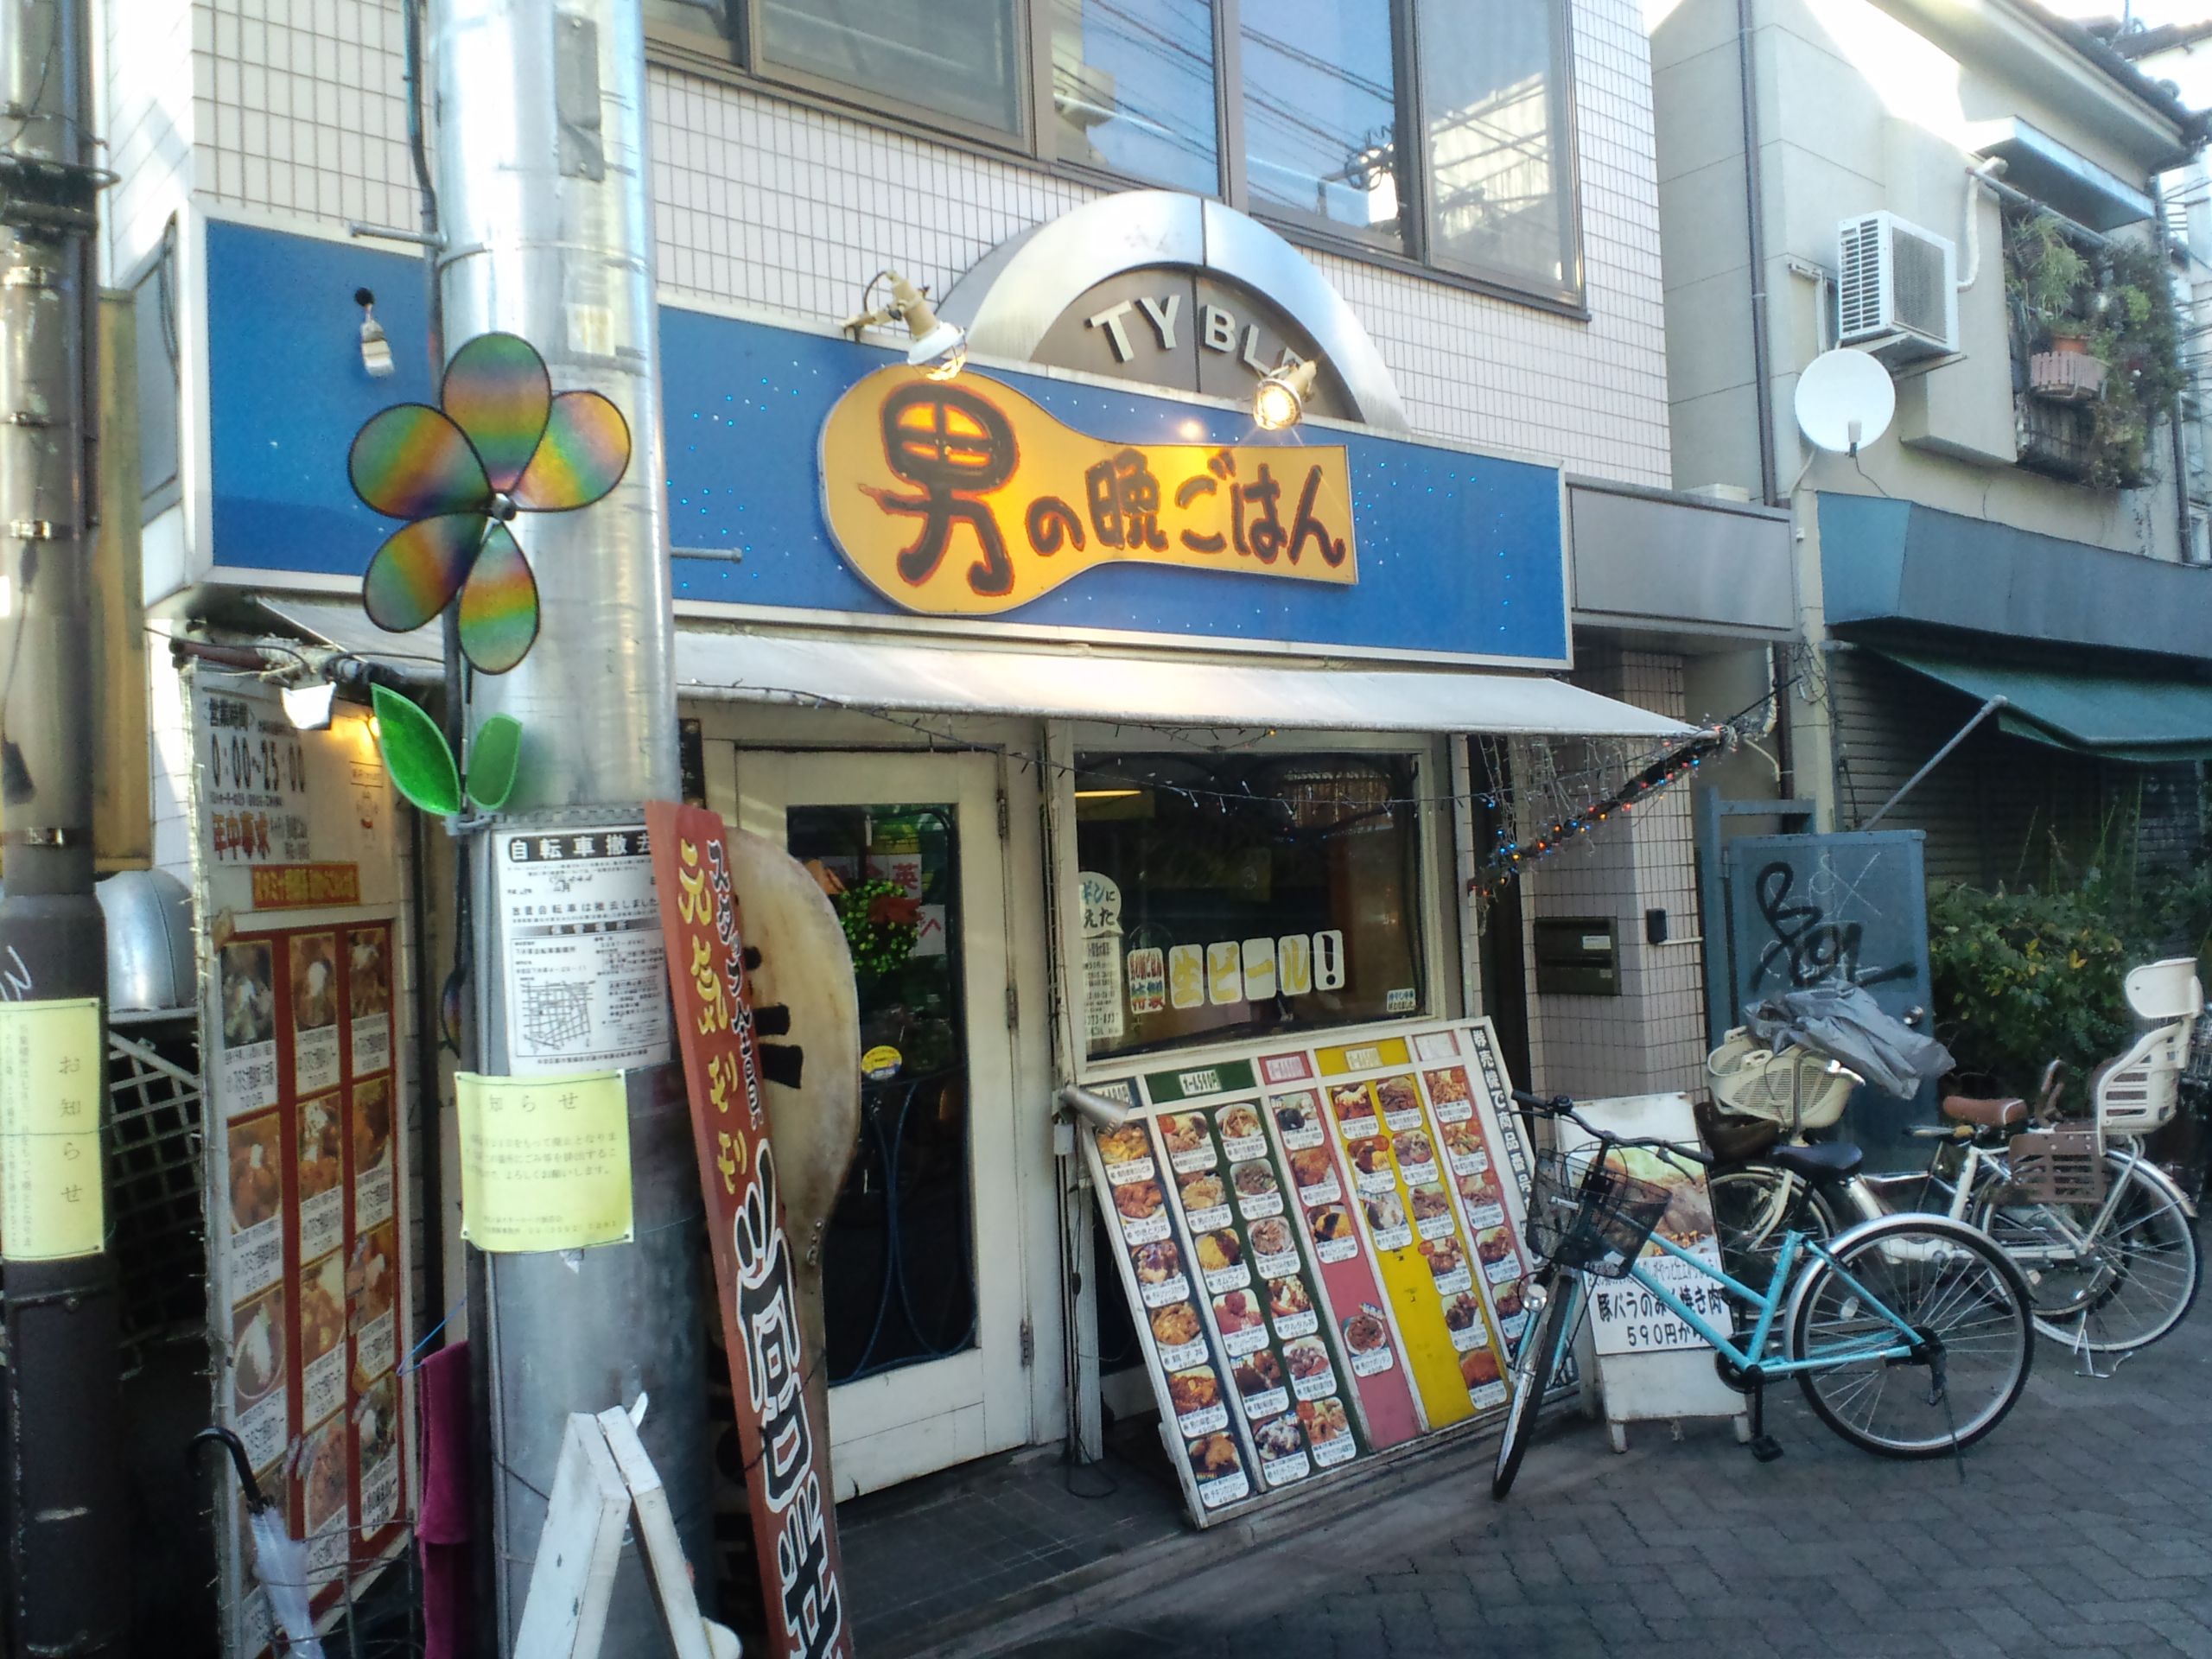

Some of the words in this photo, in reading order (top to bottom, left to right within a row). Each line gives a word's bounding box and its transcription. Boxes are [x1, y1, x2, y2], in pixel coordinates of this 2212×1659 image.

[1085, 295, 1181, 362] TY
[858, 379, 1346, 596] 男の晩ごはん
[677, 836, 748, 1195] 元気モリモリ
[1216, 1271, 1247, 1286] オムライス
